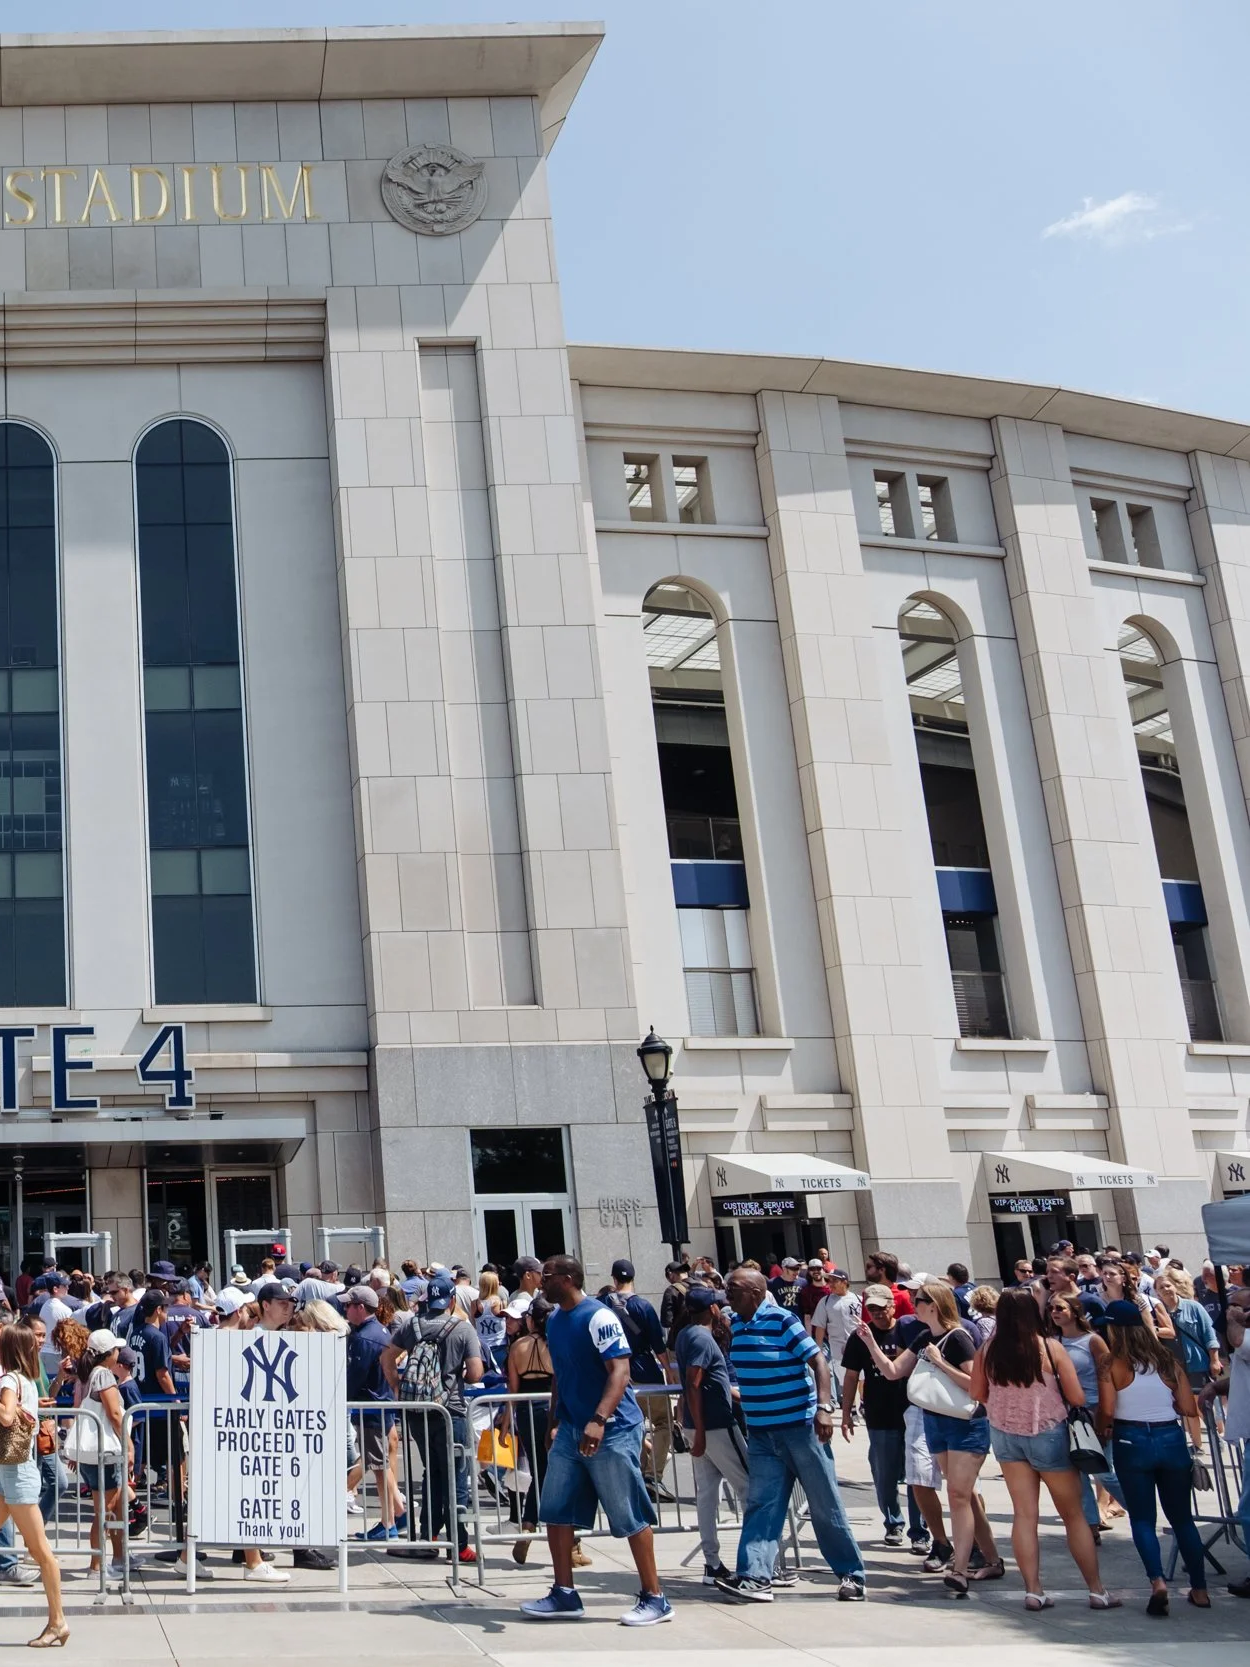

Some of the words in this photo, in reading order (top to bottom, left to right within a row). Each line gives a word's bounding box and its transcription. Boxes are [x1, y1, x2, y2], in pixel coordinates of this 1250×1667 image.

[4, 165, 322, 225] STADIUM
[135, 1023, 196, 1110] 4
[716, 1166, 728, 1187] NY
[995, 1163, 1011, 1184] NY
[1098, 1175, 1134, 1185] TICKETS
[1227, 1162, 1246, 1182] NY
[800, 1178, 841, 1188] TICKETS
[598, 1197, 641, 1211] PRESS
[722, 1202, 760, 1210] CUSTOMER
[763, 1201, 795, 1209] SERVICE
[1010, 1204, 1039, 1212] WINDOWS
[1037, 1198, 1065, 1206] TICKETS
[600, 1210, 643, 1228] GATE
[733, 1208, 765, 1216] WINDOWS
[768, 1208, 783, 1216] 1-2
[431, 1286, 440, 1296] NY
[782, 1293, 797, 1307] NY
[848, 1303, 862, 1317] NY
[480, 1319, 498, 1334] NY
[597, 1323, 619, 1342] NIKE
[240, 1335, 300, 1404] NY
[213, 1407, 265, 1429] EARLY
[273, 1409, 327, 1431] GATES
[217, 1431, 295, 1454] PROCEED
[303, 1433, 324, 1455] TO
[240, 1456, 282, 1477] GATE
[290, 1457, 300, 1477] 6
[262, 1479, 279, 1496] or
[240, 1498, 282, 1520] GATE
[290, 1499, 300, 1520] 8
[237, 1521, 274, 1538] Thank
[279, 1523, 305, 1540] you!
